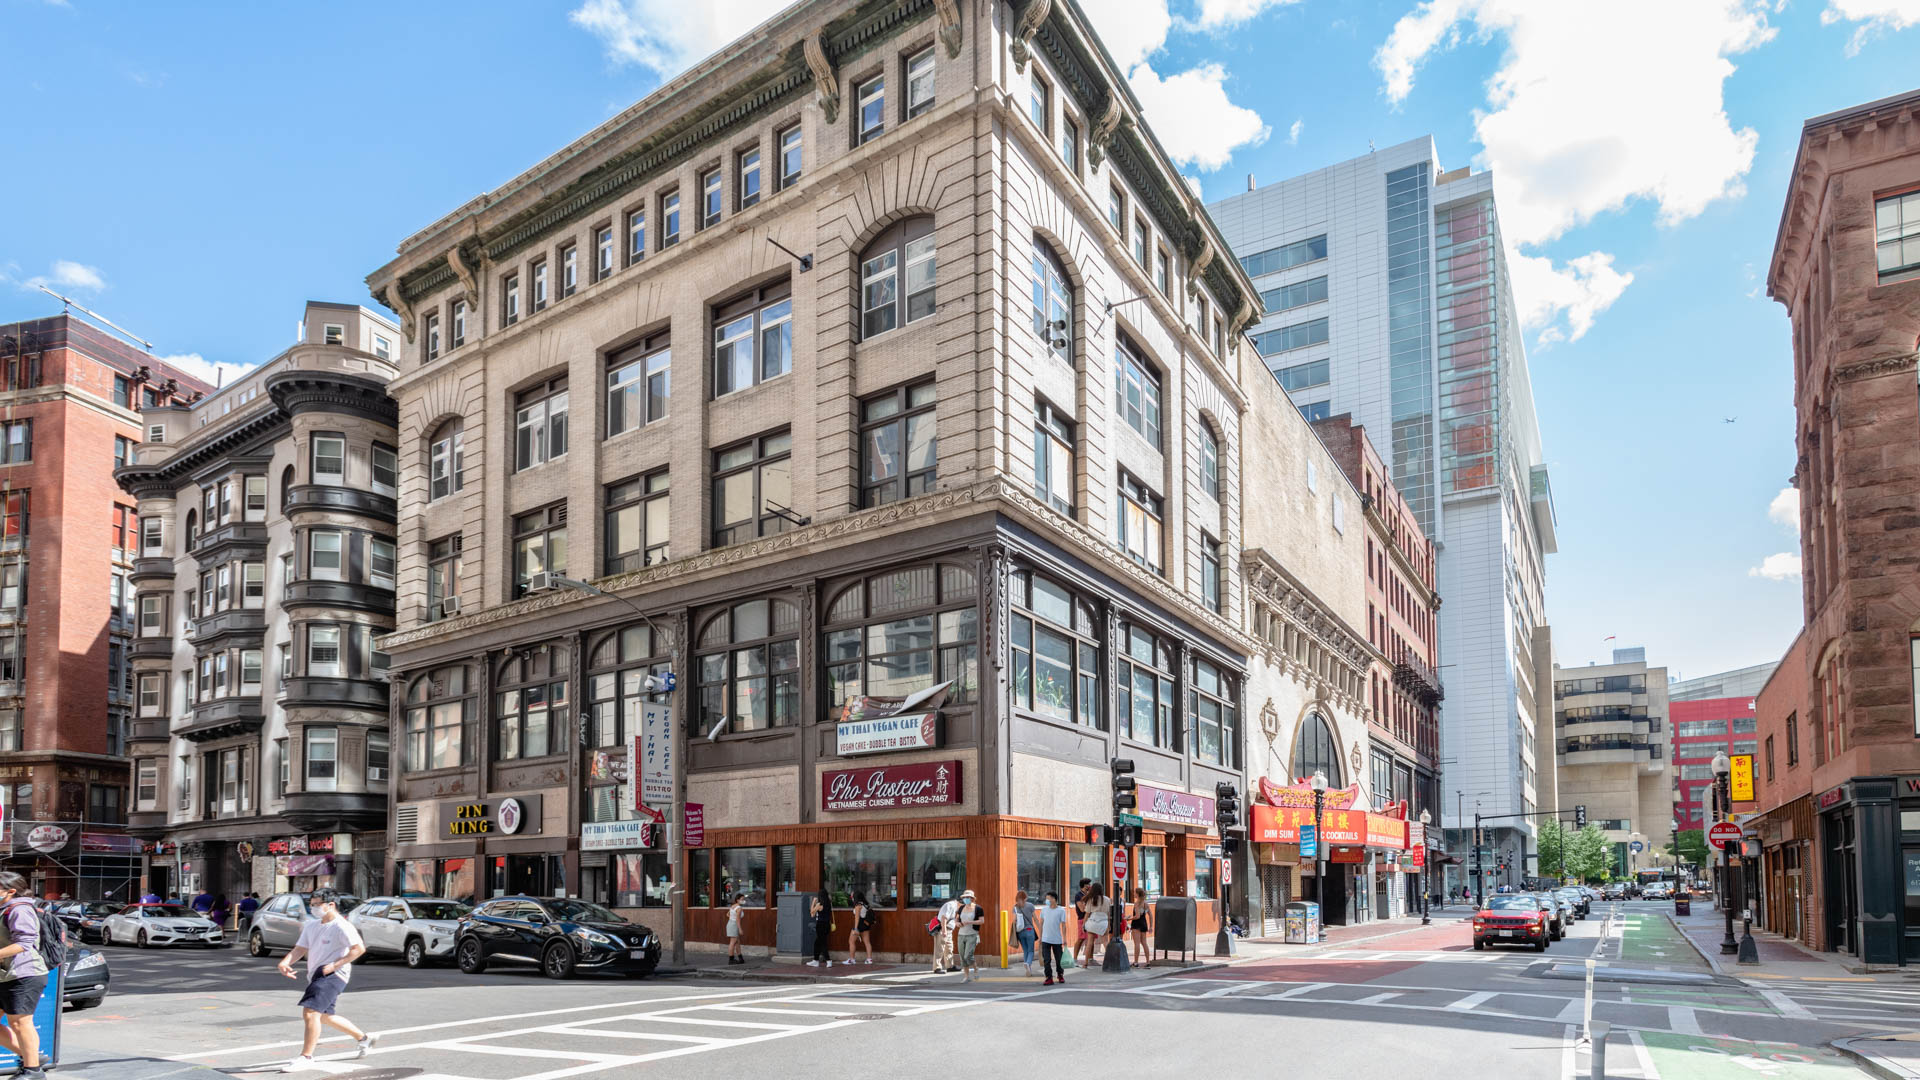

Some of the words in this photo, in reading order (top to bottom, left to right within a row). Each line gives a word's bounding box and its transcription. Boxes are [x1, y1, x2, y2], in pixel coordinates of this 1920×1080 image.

[647, 712, 655, 726] MY
[838, 726, 849, 736] MY
[852, 724, 870, 734] THAI
[872, 721, 898, 732] VEGAN
[900, 719, 919, 729] CAFE
[647, 734, 655, 764] THAI
[840, 742, 854, 752] VEGAN
[855, 741, 866, 750] CAKE
[869, 739, 886, 748] BUBBLE
[887, 738, 896, 747] TEA
[899, 736, 917, 746] BISTRO
[663, 746, 671, 770] CAFE
[646, 785, 672, 793] BISTRO
[827, 773, 862, 800] Pho
[863, 771, 933, 798] Pasteur
[827, 800, 867, 809] VIETNAMESE
[869, 798, 895, 807] CUISINE
[901, 795, 949, 804] 617-482-7467
[456, 804, 483, 818] PIN
[449, 820, 488, 834] MING
[608, 824, 625, 833] VEGAN
[626, 823, 640, 831] CAFE
[1264, 829, 1278, 838] DIM
[1279, 830, 1294, 839] SUM
[1326, 831, 1358, 840] COCKTAILS
[310, 836, 333, 850] world
